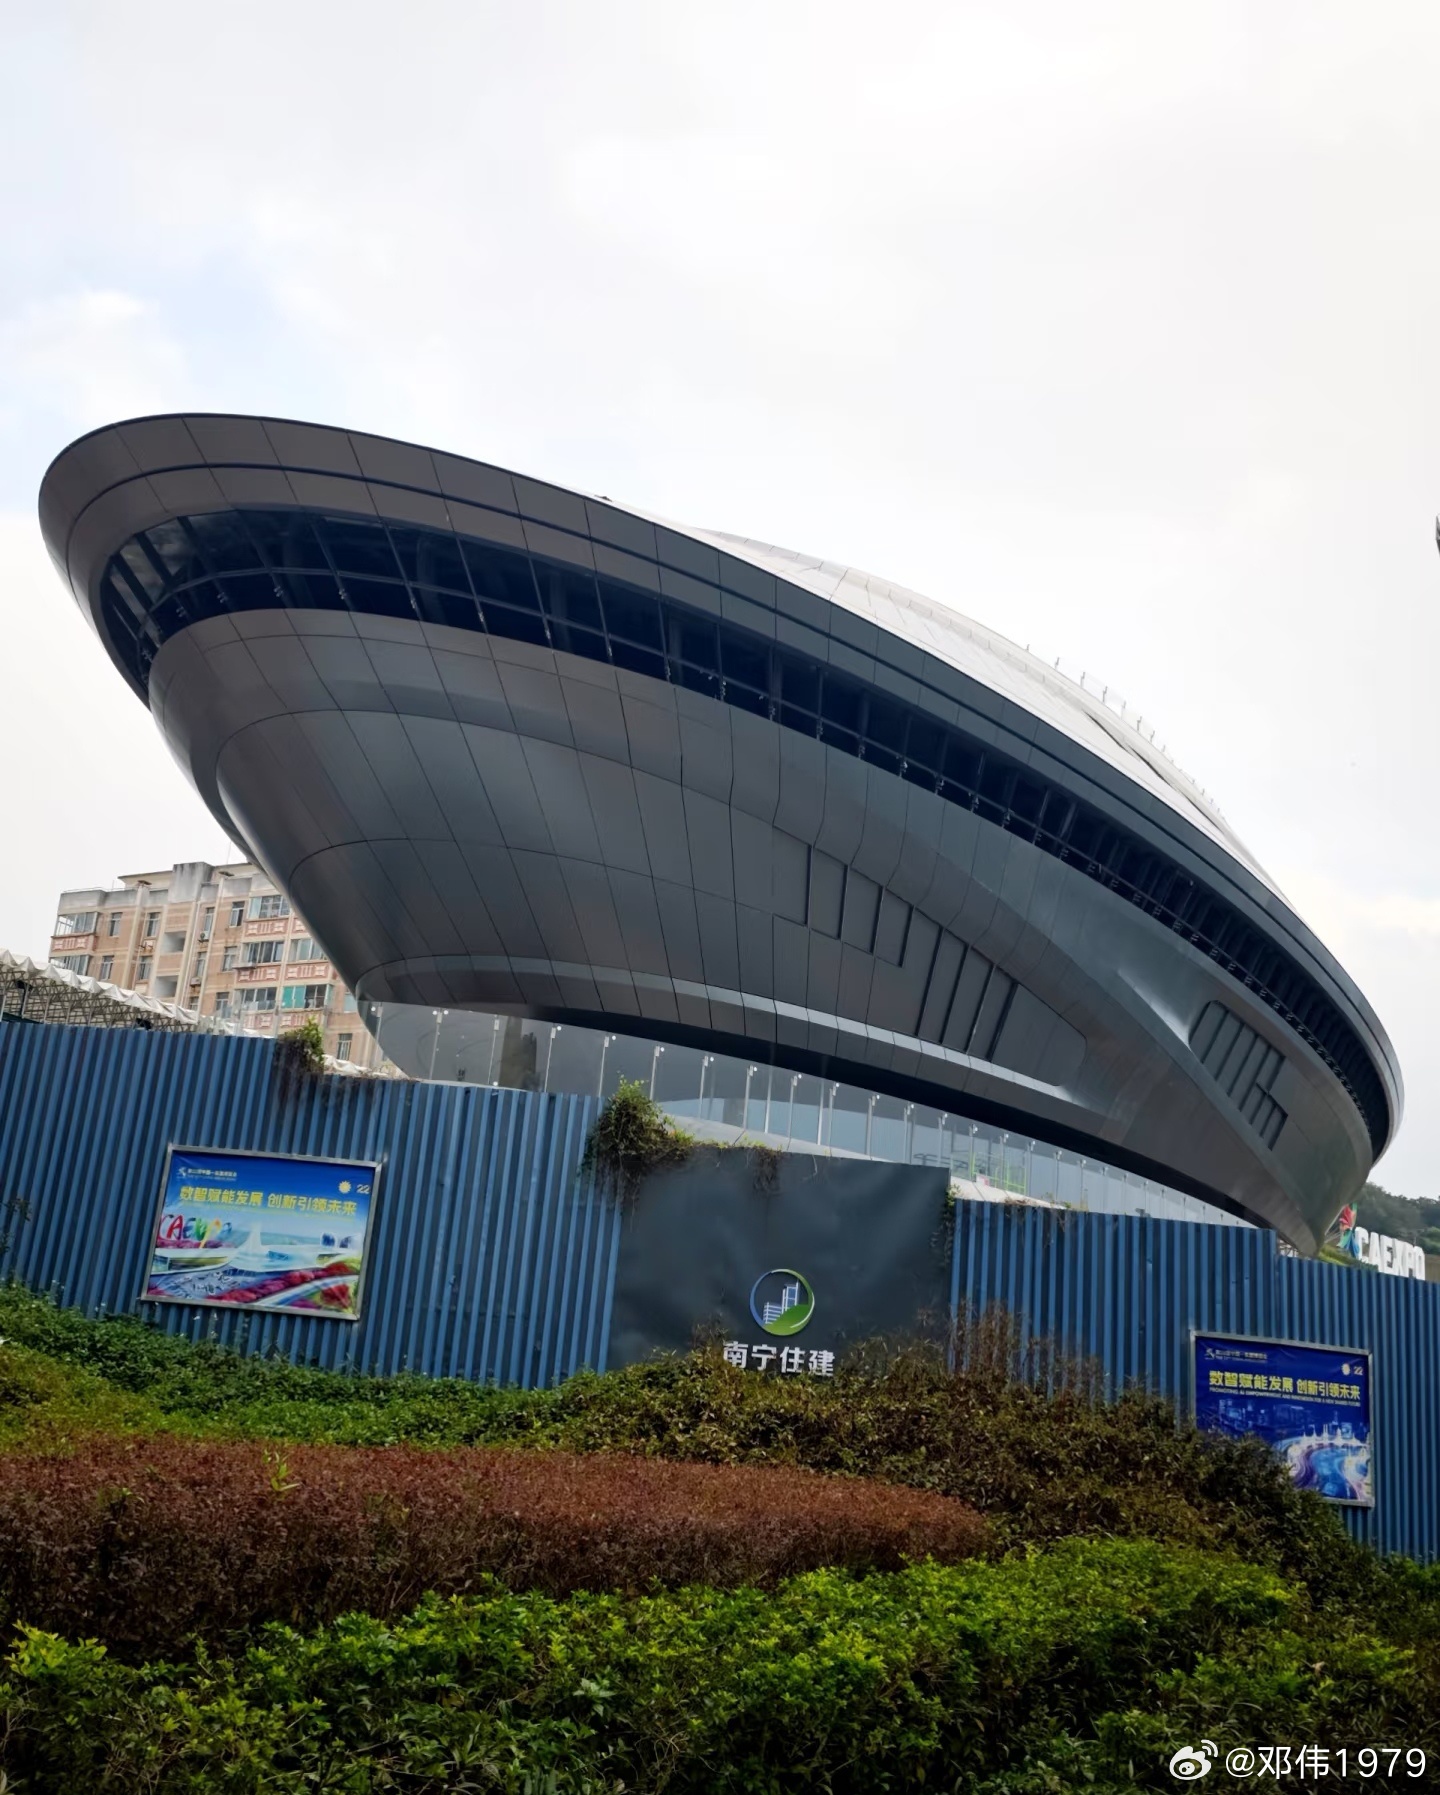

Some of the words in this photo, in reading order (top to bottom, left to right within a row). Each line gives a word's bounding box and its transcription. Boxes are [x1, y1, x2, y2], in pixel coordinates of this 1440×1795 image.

[179, 1185, 264, 1207] 数智赋能发展
[267, 1193, 357, 1216] 创新引领未来
[356, 1183, 371, 1195] 22
[1354, 1226, 1426, 1281] CAEXPO
[722, 1340, 836, 1377] 南宁住建
[1209, 1370, 1294, 1393] 数智赋能发展
[1296, 1379, 1361, 1401] 创新引领未来
